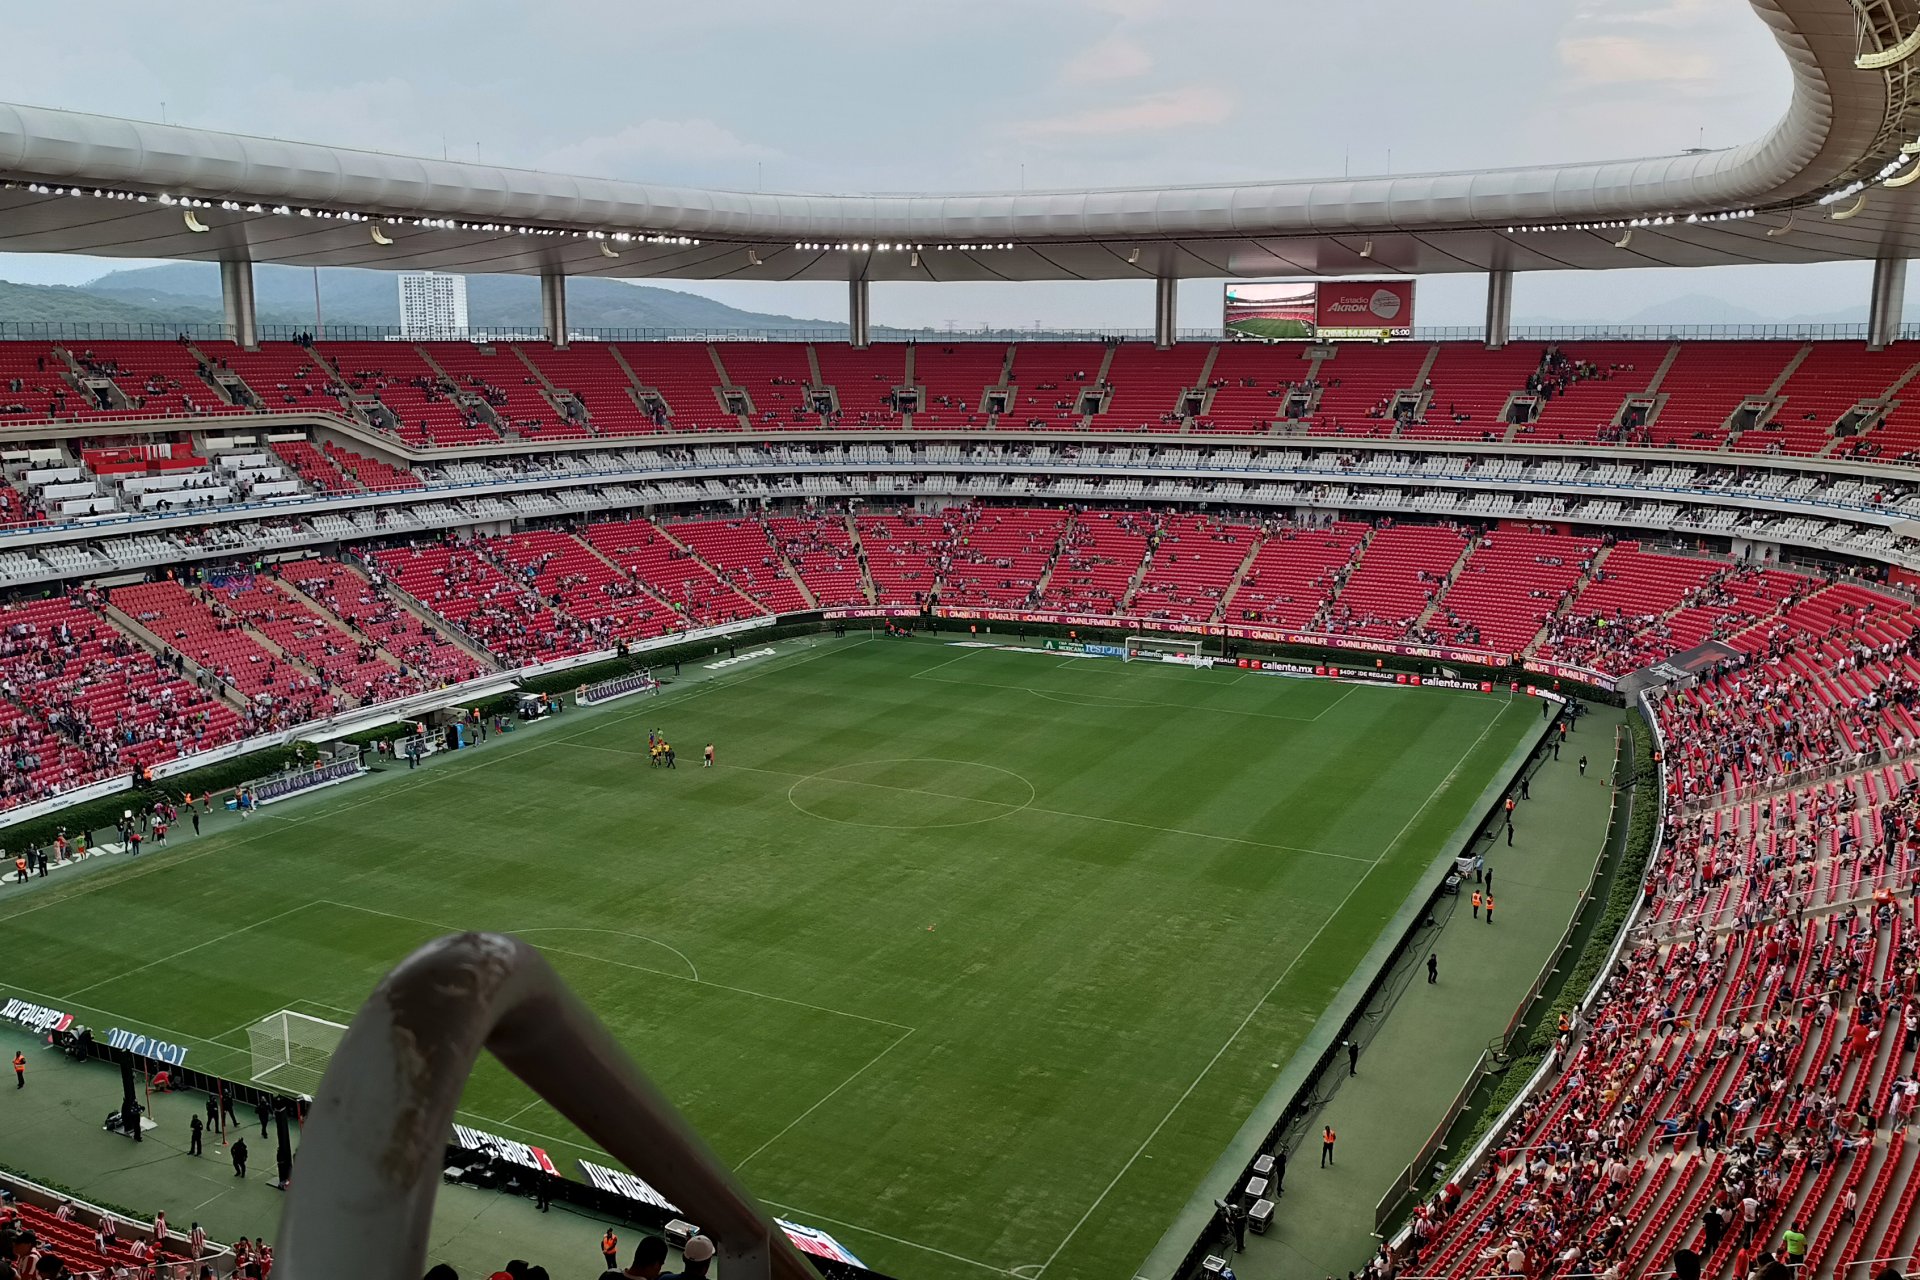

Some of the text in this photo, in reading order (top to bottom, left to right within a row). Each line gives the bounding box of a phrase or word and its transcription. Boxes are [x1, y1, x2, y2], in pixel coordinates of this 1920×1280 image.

[1327, 303, 1368, 312] AKRON
[854, 609, 887, 617] OMNILIFE
[949, 610, 981, 619] OMNILIFE
[987, 612, 1019, 621] OMNILIFE
[1027, 614, 1058, 623] OMNILIFE
[1169, 625, 1203, 634] OMNILIFE
[1251, 630, 1286, 642] OMNILIFE
[1293, 635, 1328, 646] OMNILIFE
[1405, 647, 1442, 659] OMNILIFE
[1450, 652, 1488, 664] OMNILIFE
[1261, 662, 1314, 673] caliente.mx
[1557, 668, 1588, 682] OMNILIFE
[1421, 677, 1479, 690] caliente.mx
[0, 997, 65, 1034] caliente.mx
